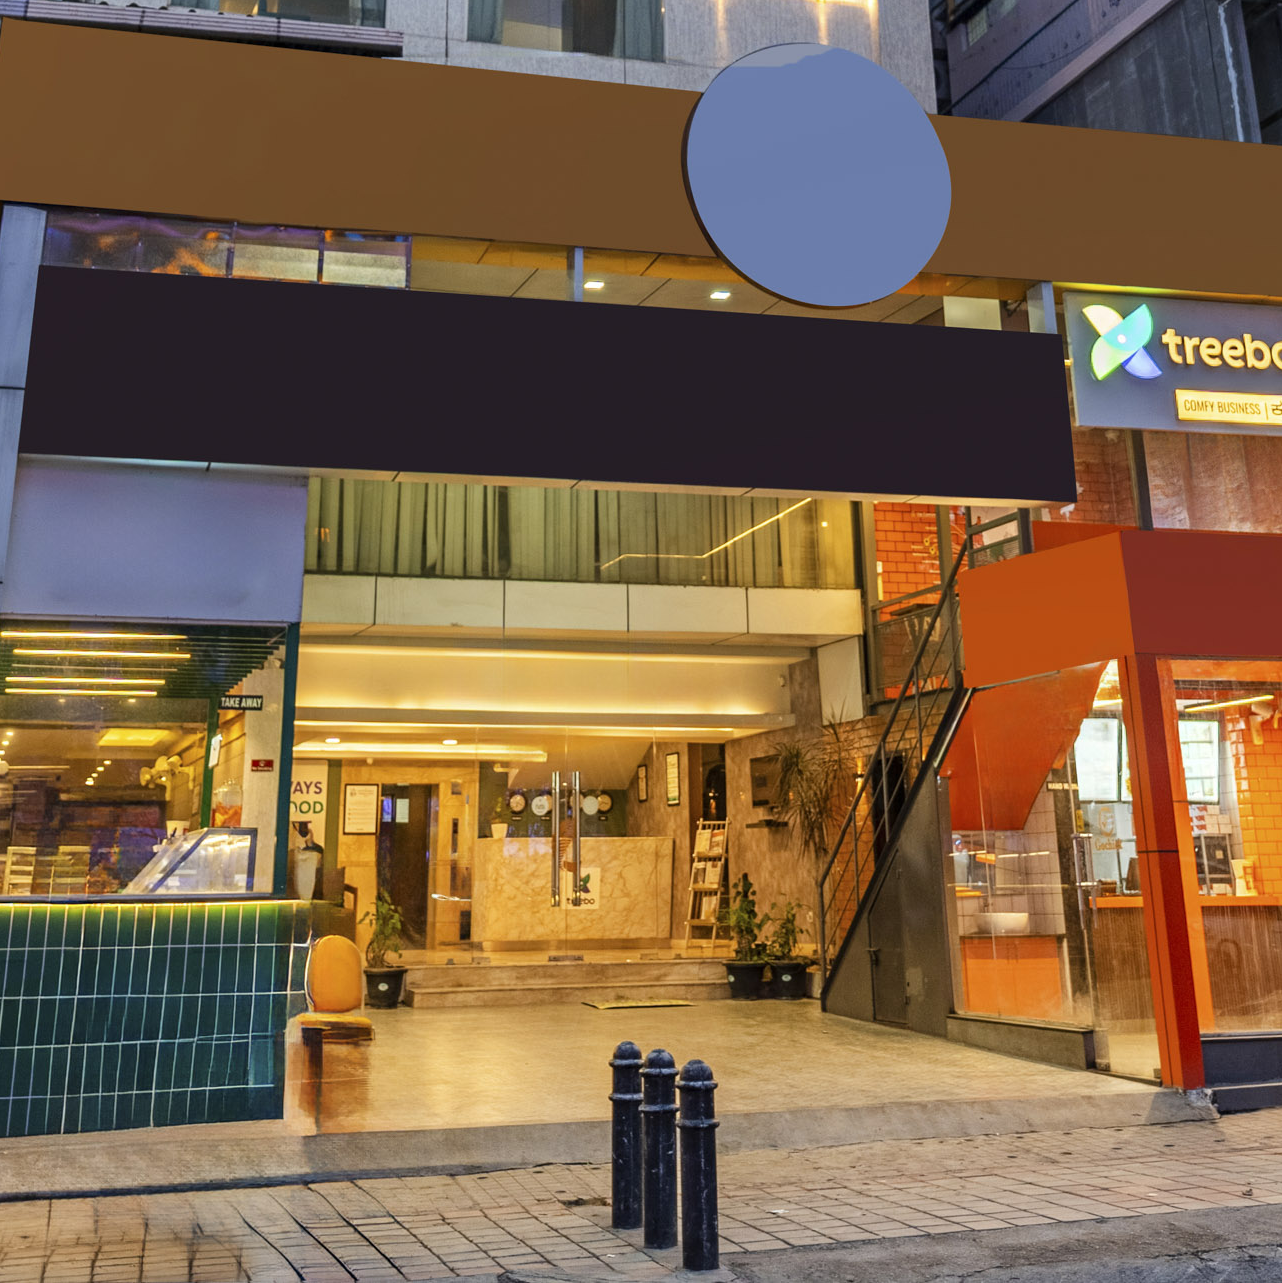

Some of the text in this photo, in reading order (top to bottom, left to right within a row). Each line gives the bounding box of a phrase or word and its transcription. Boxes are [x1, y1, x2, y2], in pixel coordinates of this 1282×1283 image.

[1183, 399, 1261, 415] COMFY BUSINESS
[221, 697, 262, 708] TAKE AWAY
[290, 781, 323, 795] AYS
